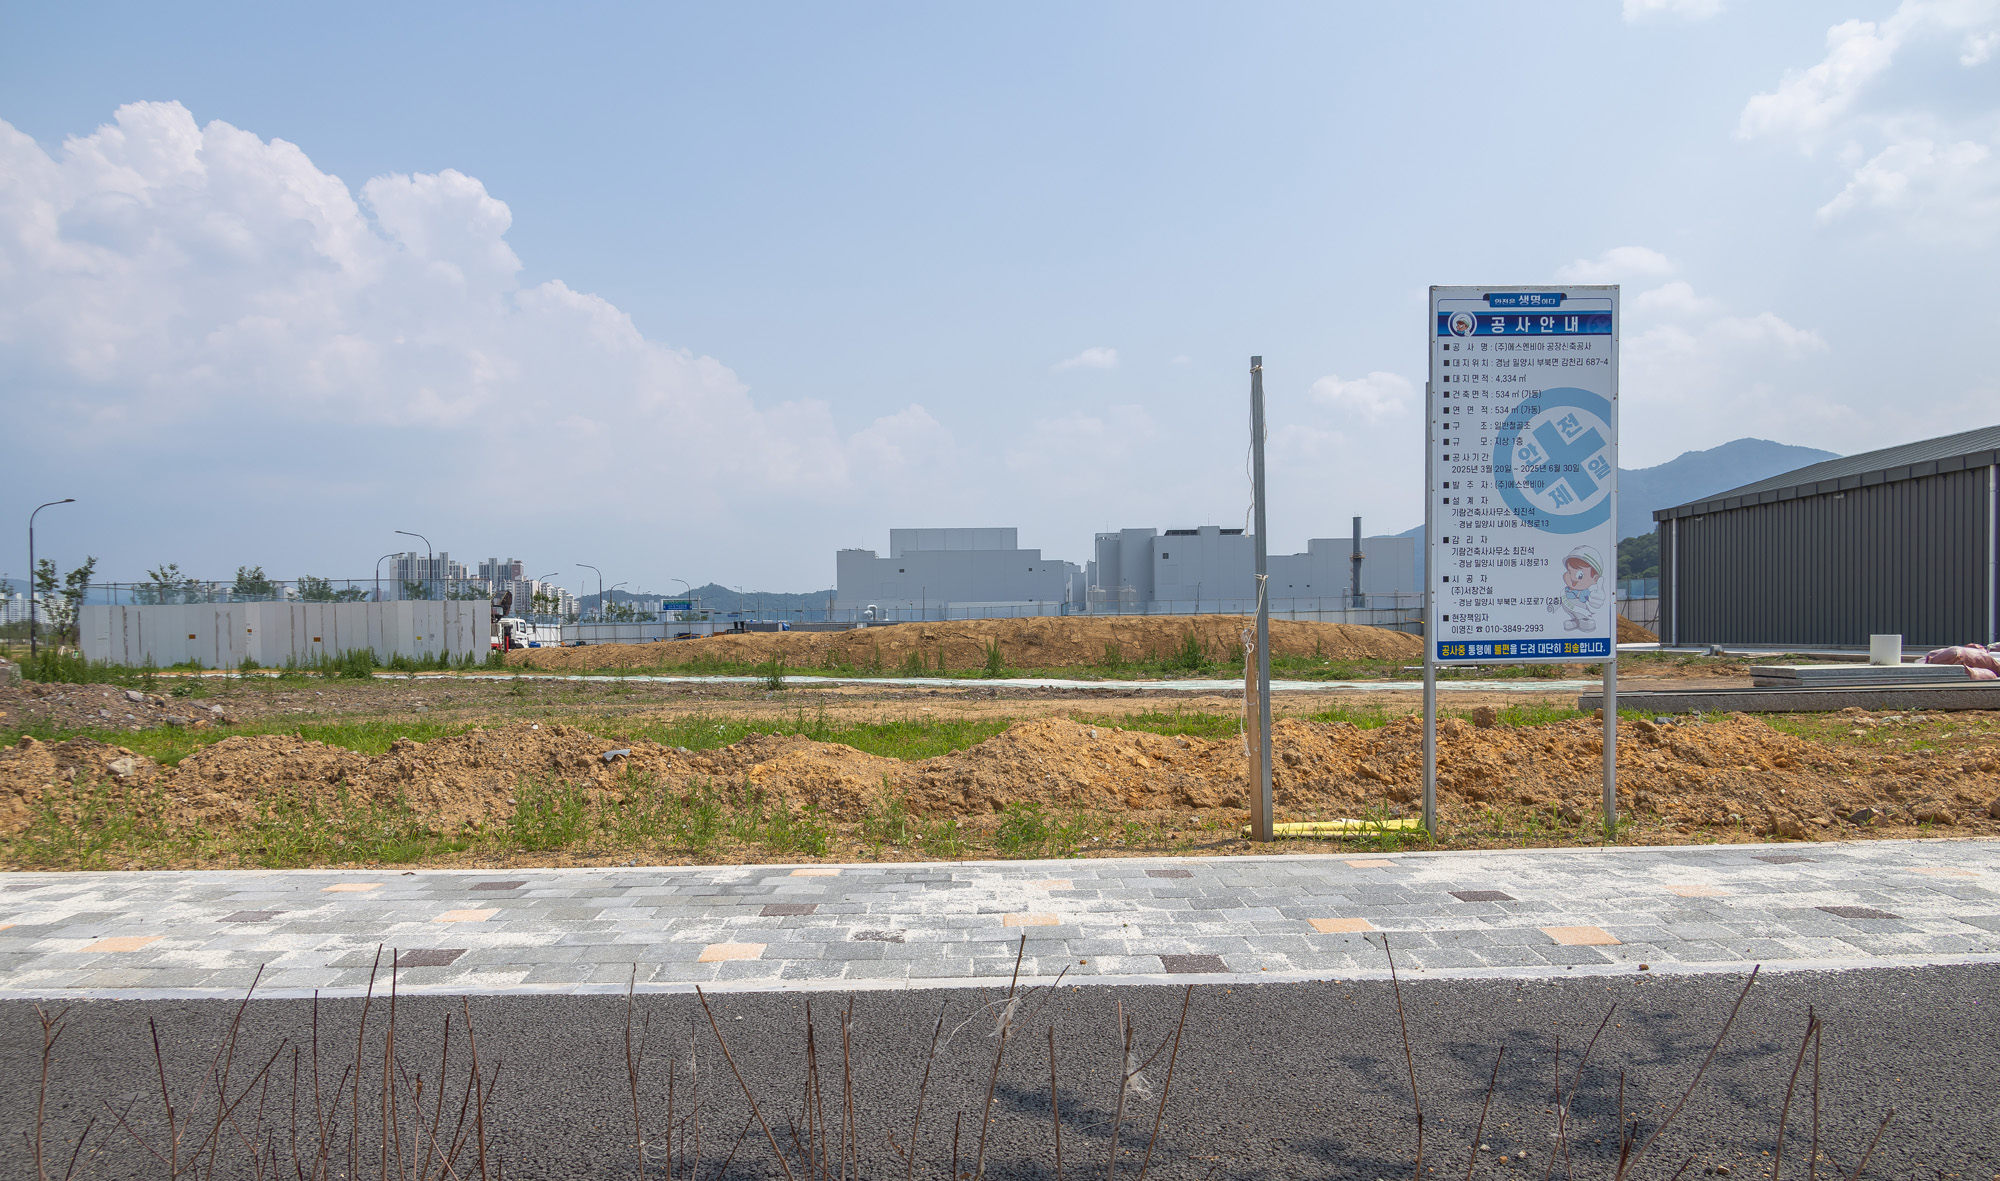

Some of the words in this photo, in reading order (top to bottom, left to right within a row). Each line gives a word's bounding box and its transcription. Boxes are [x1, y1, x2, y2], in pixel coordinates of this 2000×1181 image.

[1518, 295, 1555, 305] 생명이다
[1547, 342, 1591, 351] 공장신축공사
[1496, 359, 1510, 367] 경남
[1513, 358, 1534, 367] 밀양시
[1537, 358, 1558, 366] 부북면
[1562, 358, 1583, 366] 감천리
[1522, 390, 1541, 398] (가동)
[1521, 405, 1541, 414] (가동)
[1495, 422, 1530, 430] 일반철골조
[1495, 437, 1509, 446] 지상
[1452, 465, 1478, 473] 2025년
[1481, 465, 1492, 473] 3월
[1495, 465, 1511, 473] 20일
[1549, 464, 1560, 472] 6월
[1563, 464, 1579, 472] 30일
[1513, 508, 1535, 516] 최진석
[1497, 520, 1517, 528] 내이동
[1513, 547, 1535, 555] 최진석
[1459, 560, 1472, 568] 경남
[1474, 559, 1494, 567] 밀양시
[1451, 586, 1493, 595] (주)서창건설
[1546, 597, 1562, 605] (2층)
[1452, 613, 1489, 622] 현장책임자
[1452, 625, 1473, 634] 이영진
[1485, 624, 1544, 633] 010-3849-2993
[1442, 645, 1465, 656] 공사중
[1468, 644, 1492, 655] 통행에
[1494, 644, 1517, 655] 불편을
[1520, 643, 1535, 654] 드려
[1538, 643, 1561, 654] 대단히
[1564, 642, 1606, 653] 죄송합니다.
